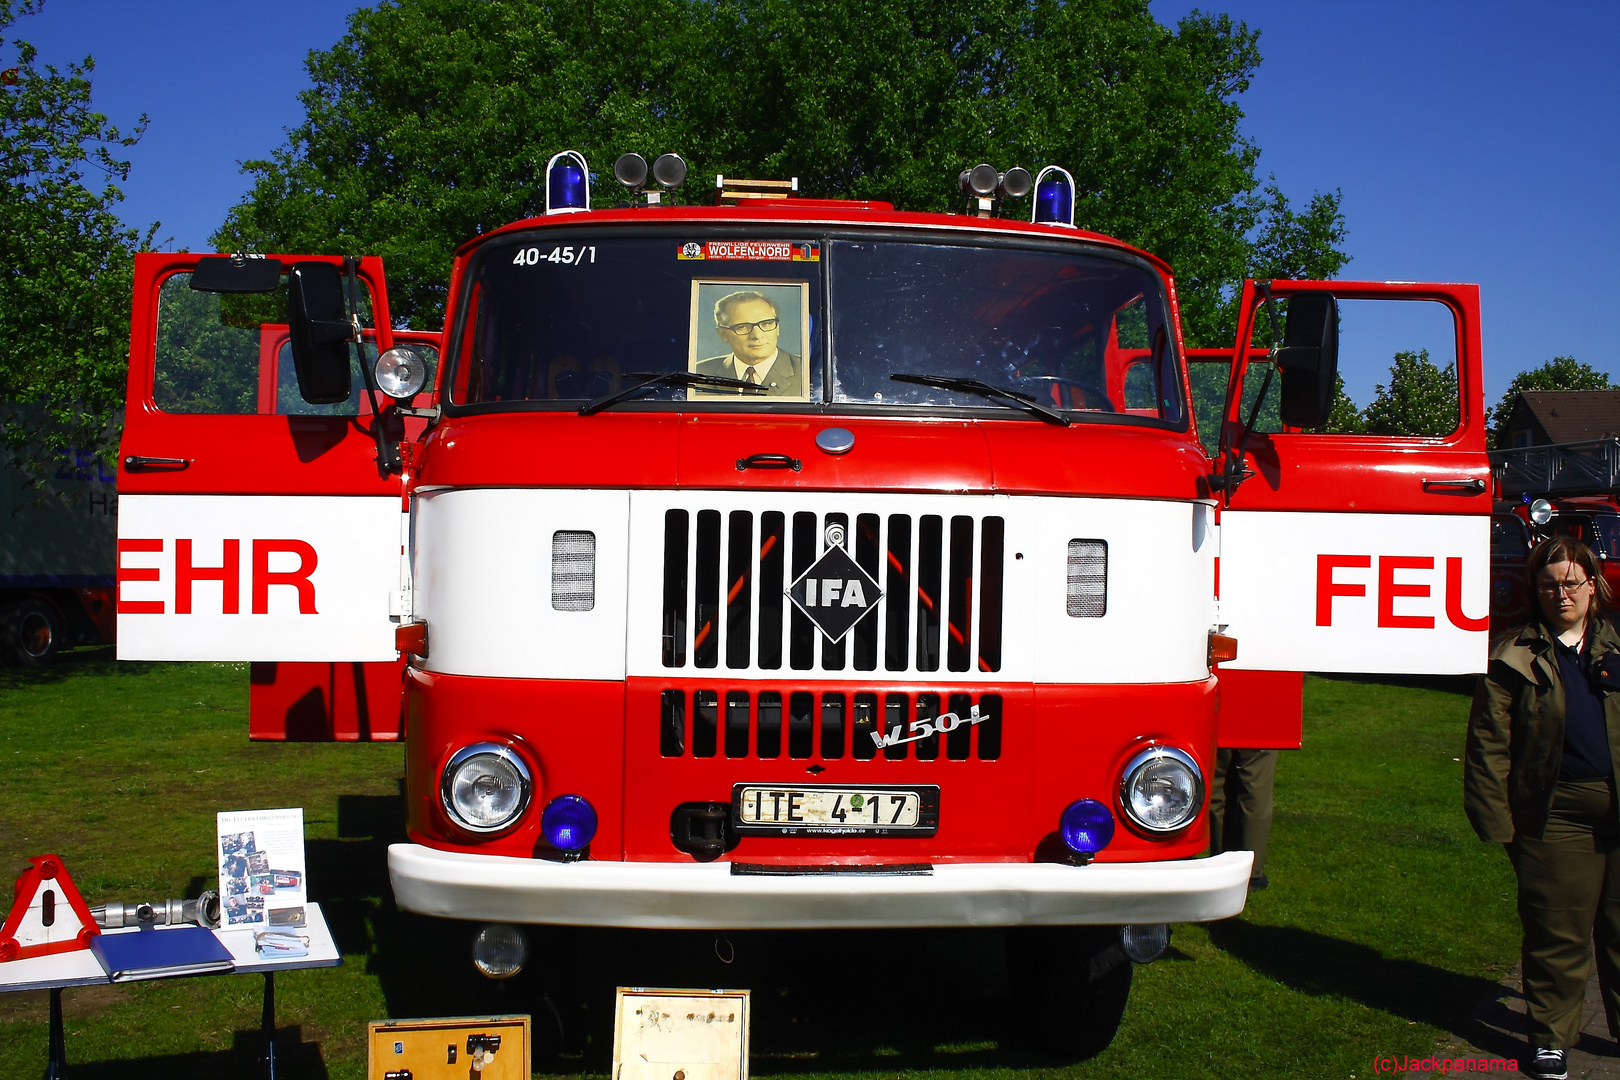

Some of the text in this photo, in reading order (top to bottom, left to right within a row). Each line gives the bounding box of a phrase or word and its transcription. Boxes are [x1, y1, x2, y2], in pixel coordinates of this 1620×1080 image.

[512, 246, 596, 266] 40-45/1
[708, 246, 790, 257] WOLFEN-NORD
[117, 538, 319, 614] EHR
[805, 578, 868, 608] IFA
[755, 791, 804, 821] ITE
